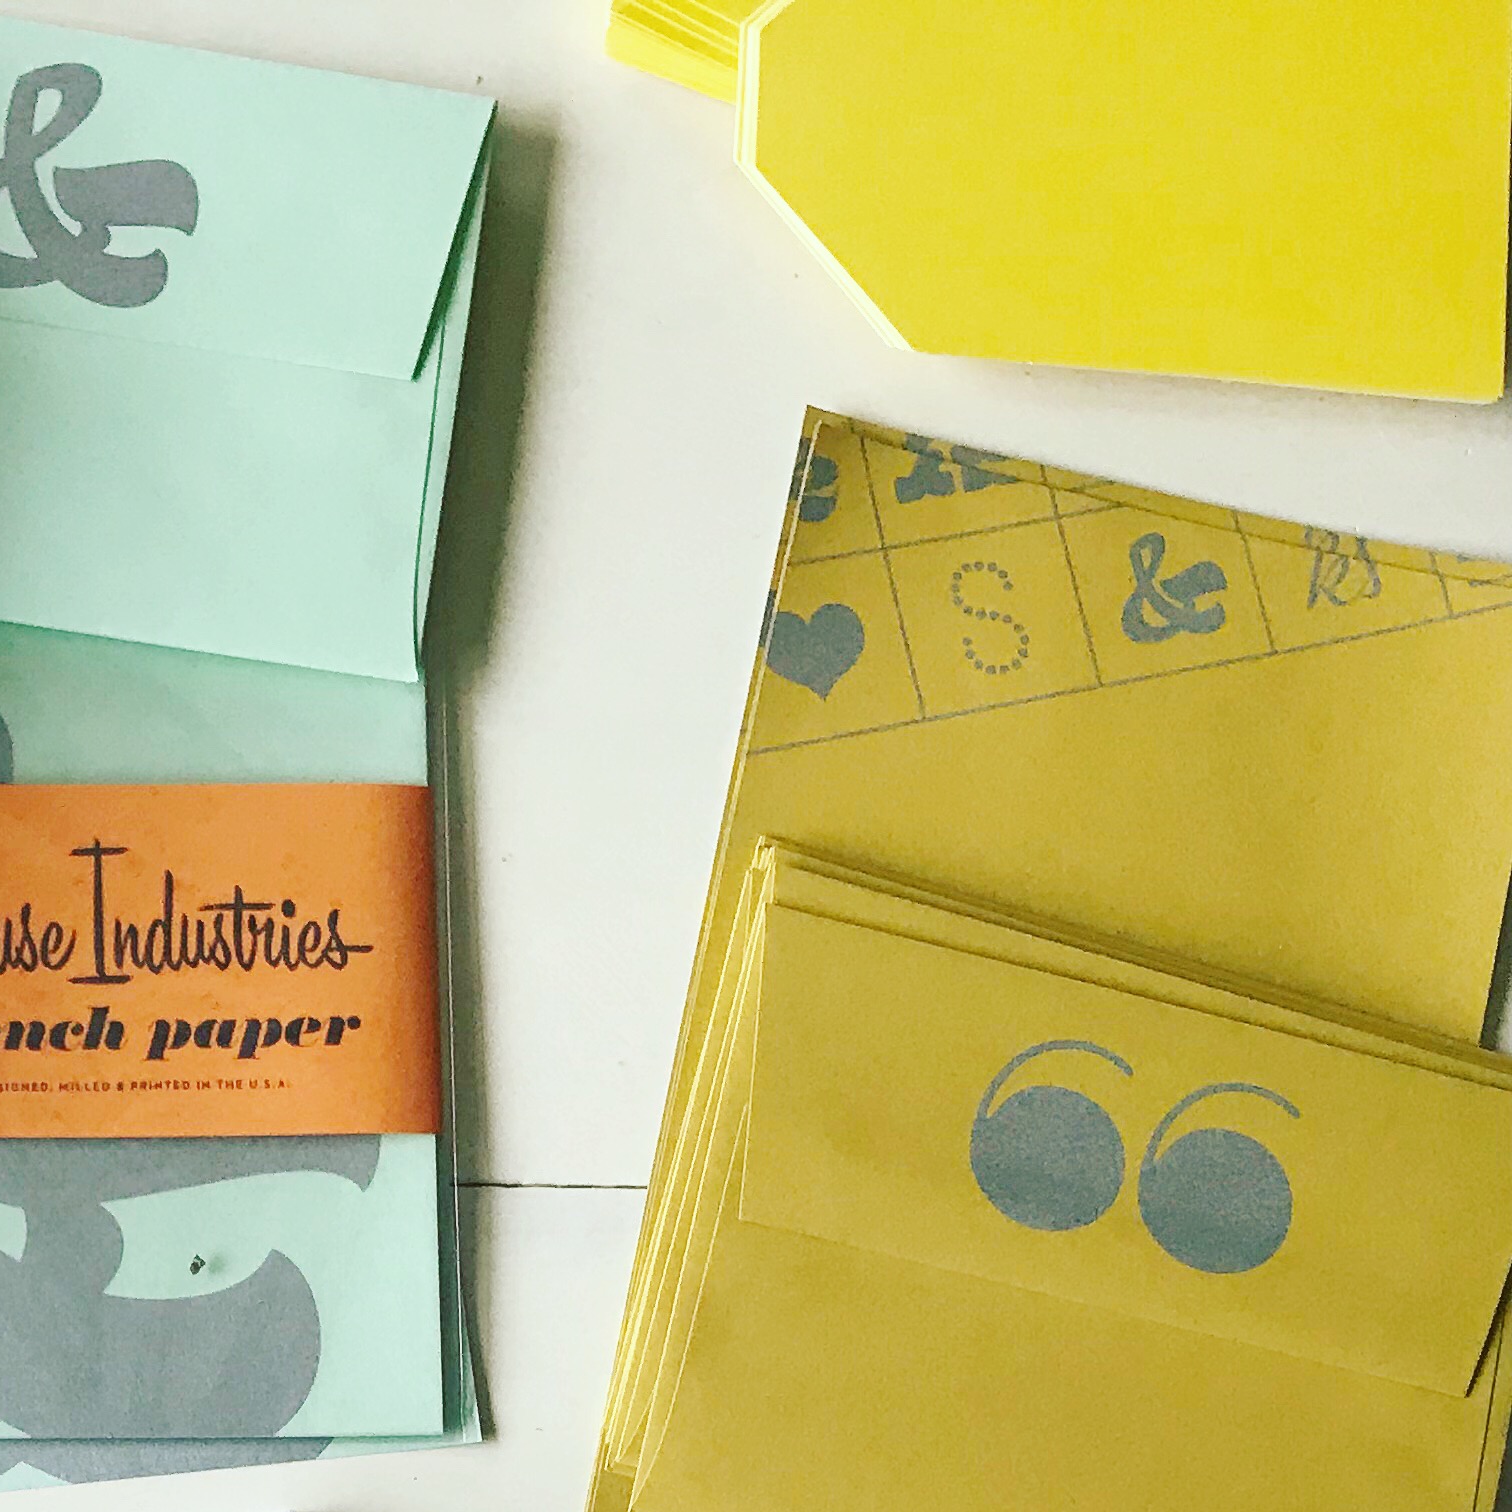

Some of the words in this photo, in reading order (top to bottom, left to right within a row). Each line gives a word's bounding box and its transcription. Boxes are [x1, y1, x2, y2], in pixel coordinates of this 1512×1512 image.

[67, 838, 374, 986] Industries
[145, 1013, 363, 1062] paper
[58, 1081, 111, 1093] MILLED
[129, 1079, 191, 1092] PRINTED
[195, 1079, 212, 1091] IN
[217, 1078, 244, 1091] THE
